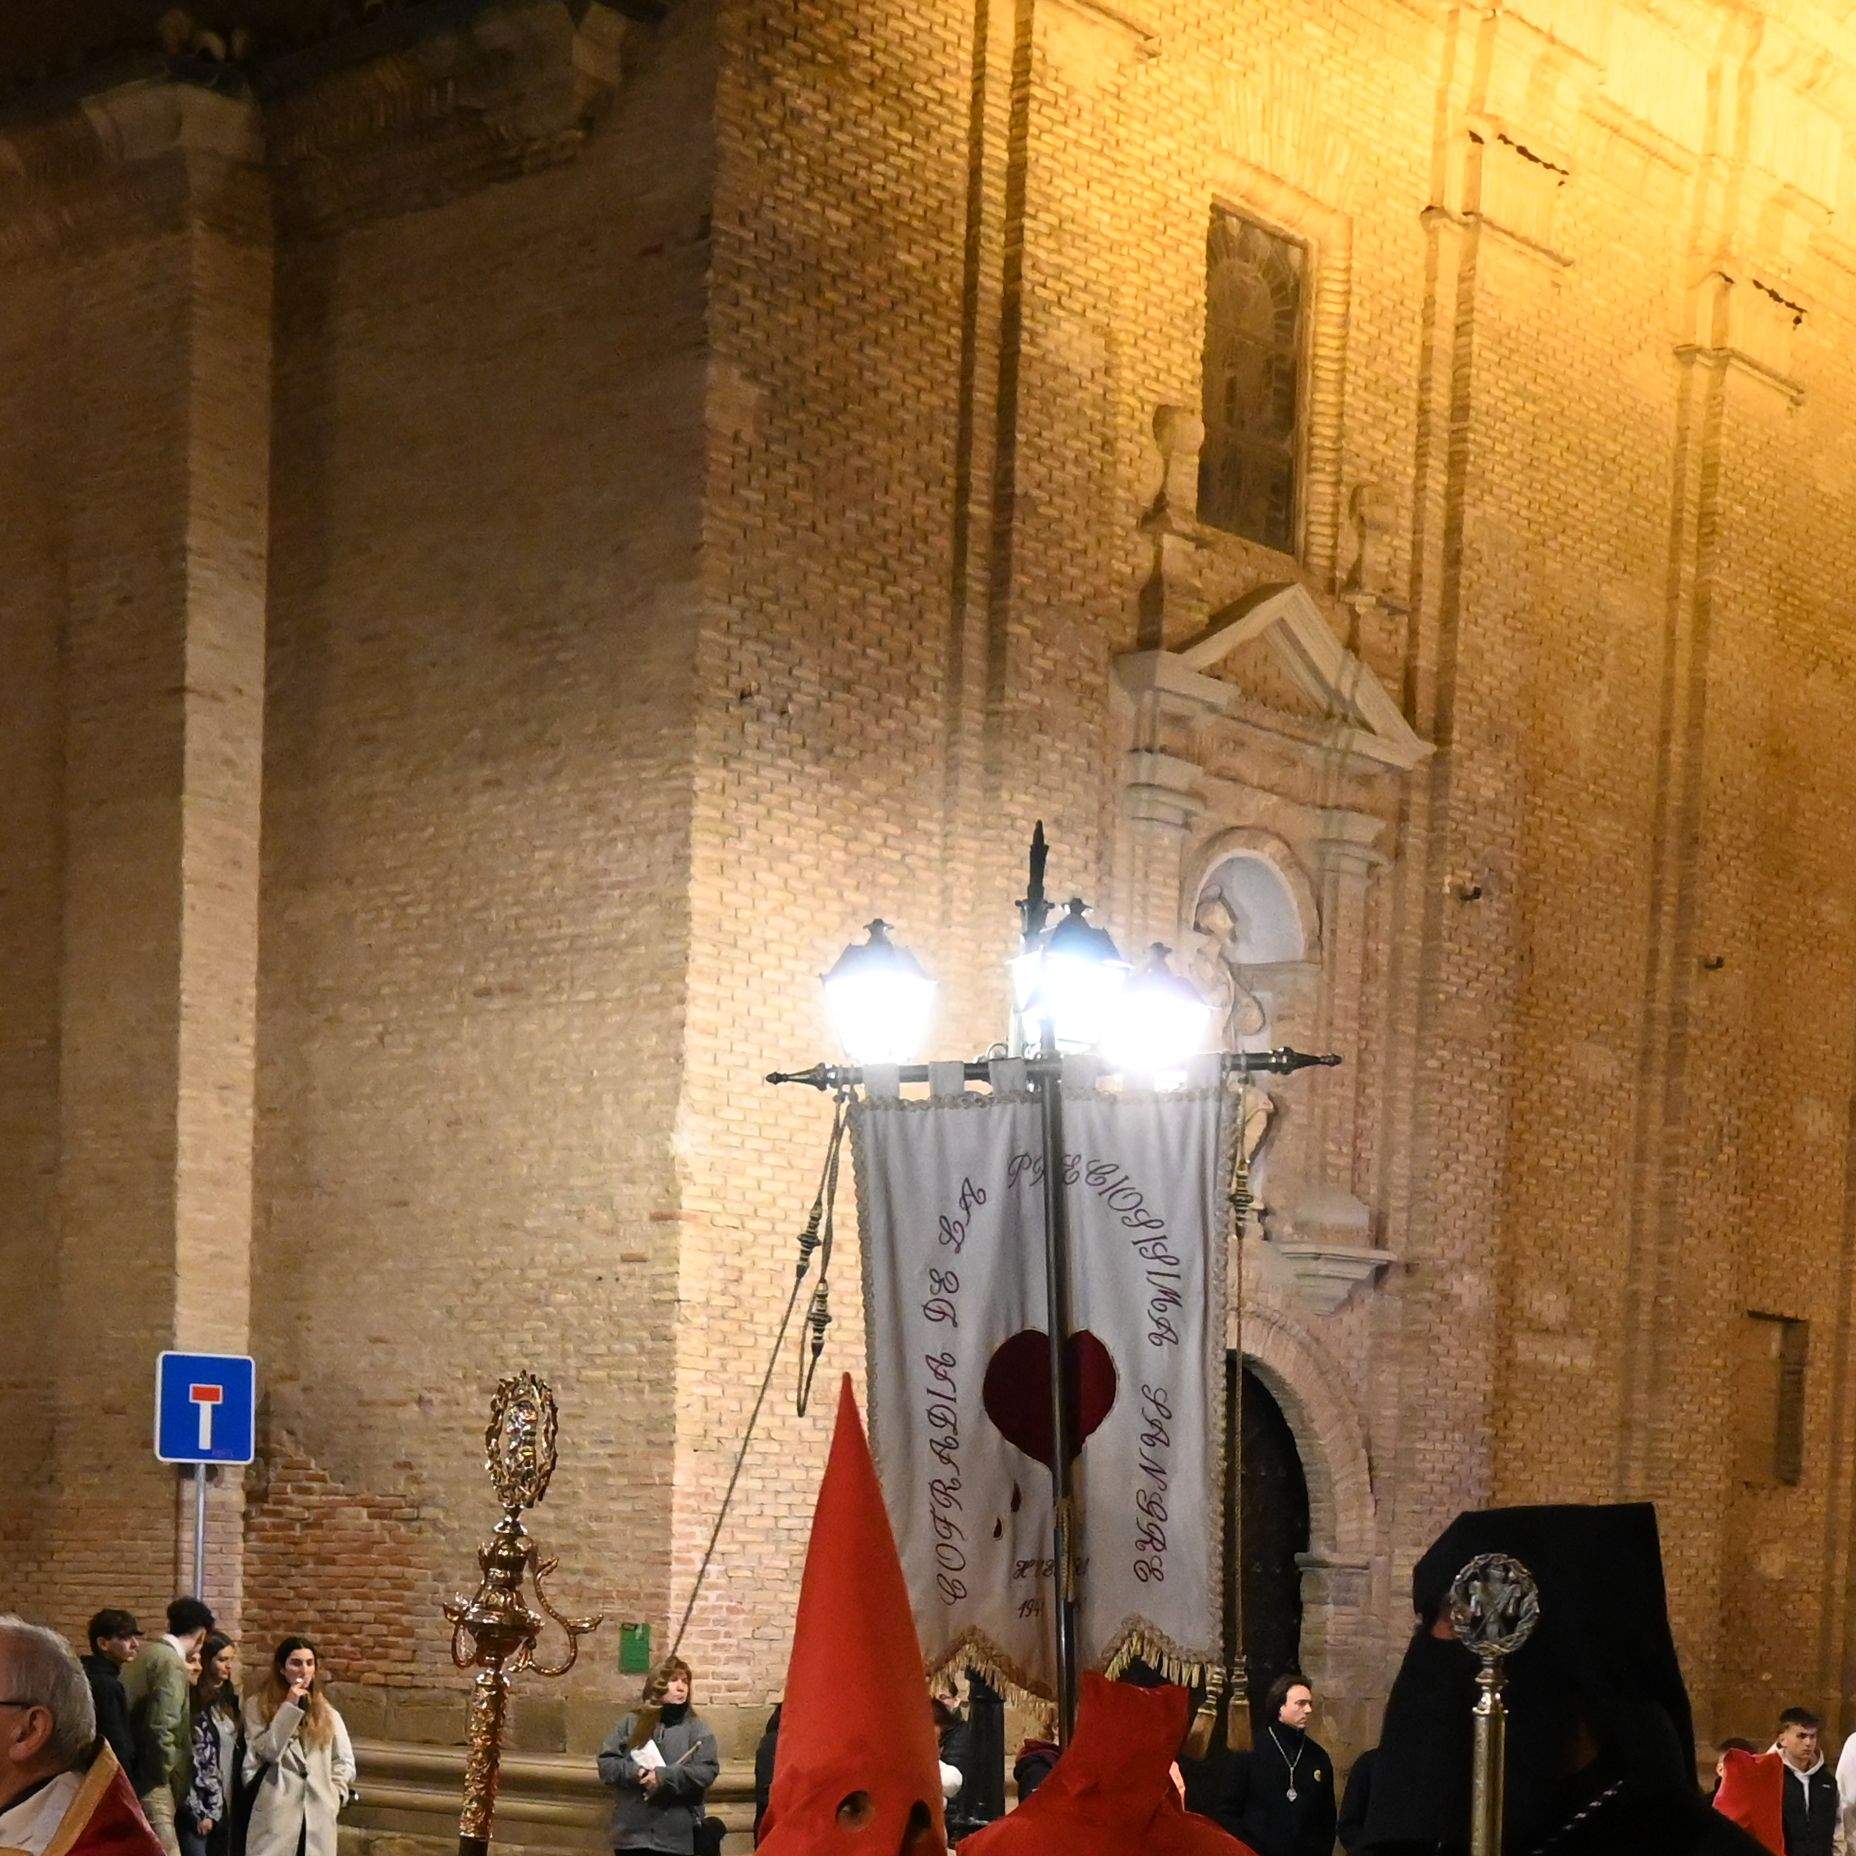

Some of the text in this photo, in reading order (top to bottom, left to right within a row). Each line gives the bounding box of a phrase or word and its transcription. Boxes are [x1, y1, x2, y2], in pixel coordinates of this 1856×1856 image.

[938, 1176, 987, 1255] LA
[921, 1267, 960, 1328] DE
[925, 1352, 968, 1606] COFRADIA
[1133, 1383, 1173, 1583] SANGRE
